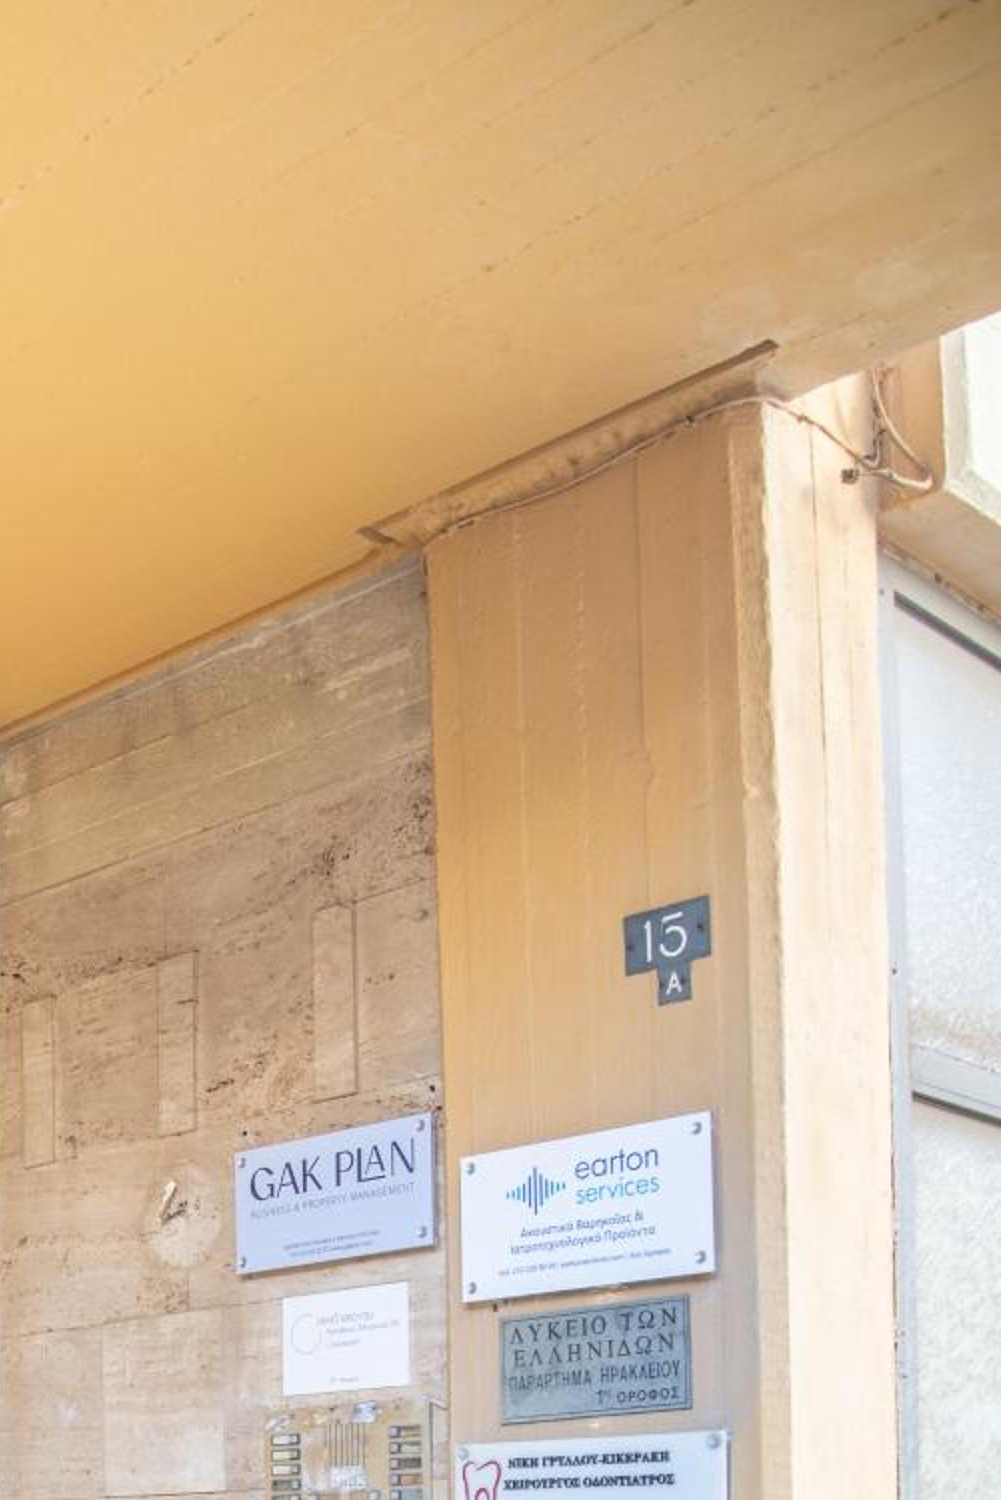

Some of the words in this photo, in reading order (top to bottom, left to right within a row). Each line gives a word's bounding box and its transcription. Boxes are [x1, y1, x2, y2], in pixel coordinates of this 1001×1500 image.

[643, 910, 688, 963] 15
[250, 1155, 323, 1201] GAK
[334, 1136, 415, 1187] PLAN
[574, 1148, 660, 1180] earton
[349, 1181, 416, 1201] MANAGEMENT
[575, 1175, 661, 1205] services
[510, 1316, 606, 1345] ΛΥΚΕΙΟ
[619, 1307, 677, 1332] ΤΩΝ
[513, 1332, 675, 1369] ΕΛΛΗΝΙΔΩΝ
[509, 1370, 592, 1392] ΠΑΡΑΡΤΗΜΑ
[600, 1359, 680, 1385] ΗΡΑΚΛΕΙΟΥ
[617, 1385, 680, 1403] ΟΡΟΦΟΣ
[508, 1457, 539, 1469] ΝΙΚΗ
